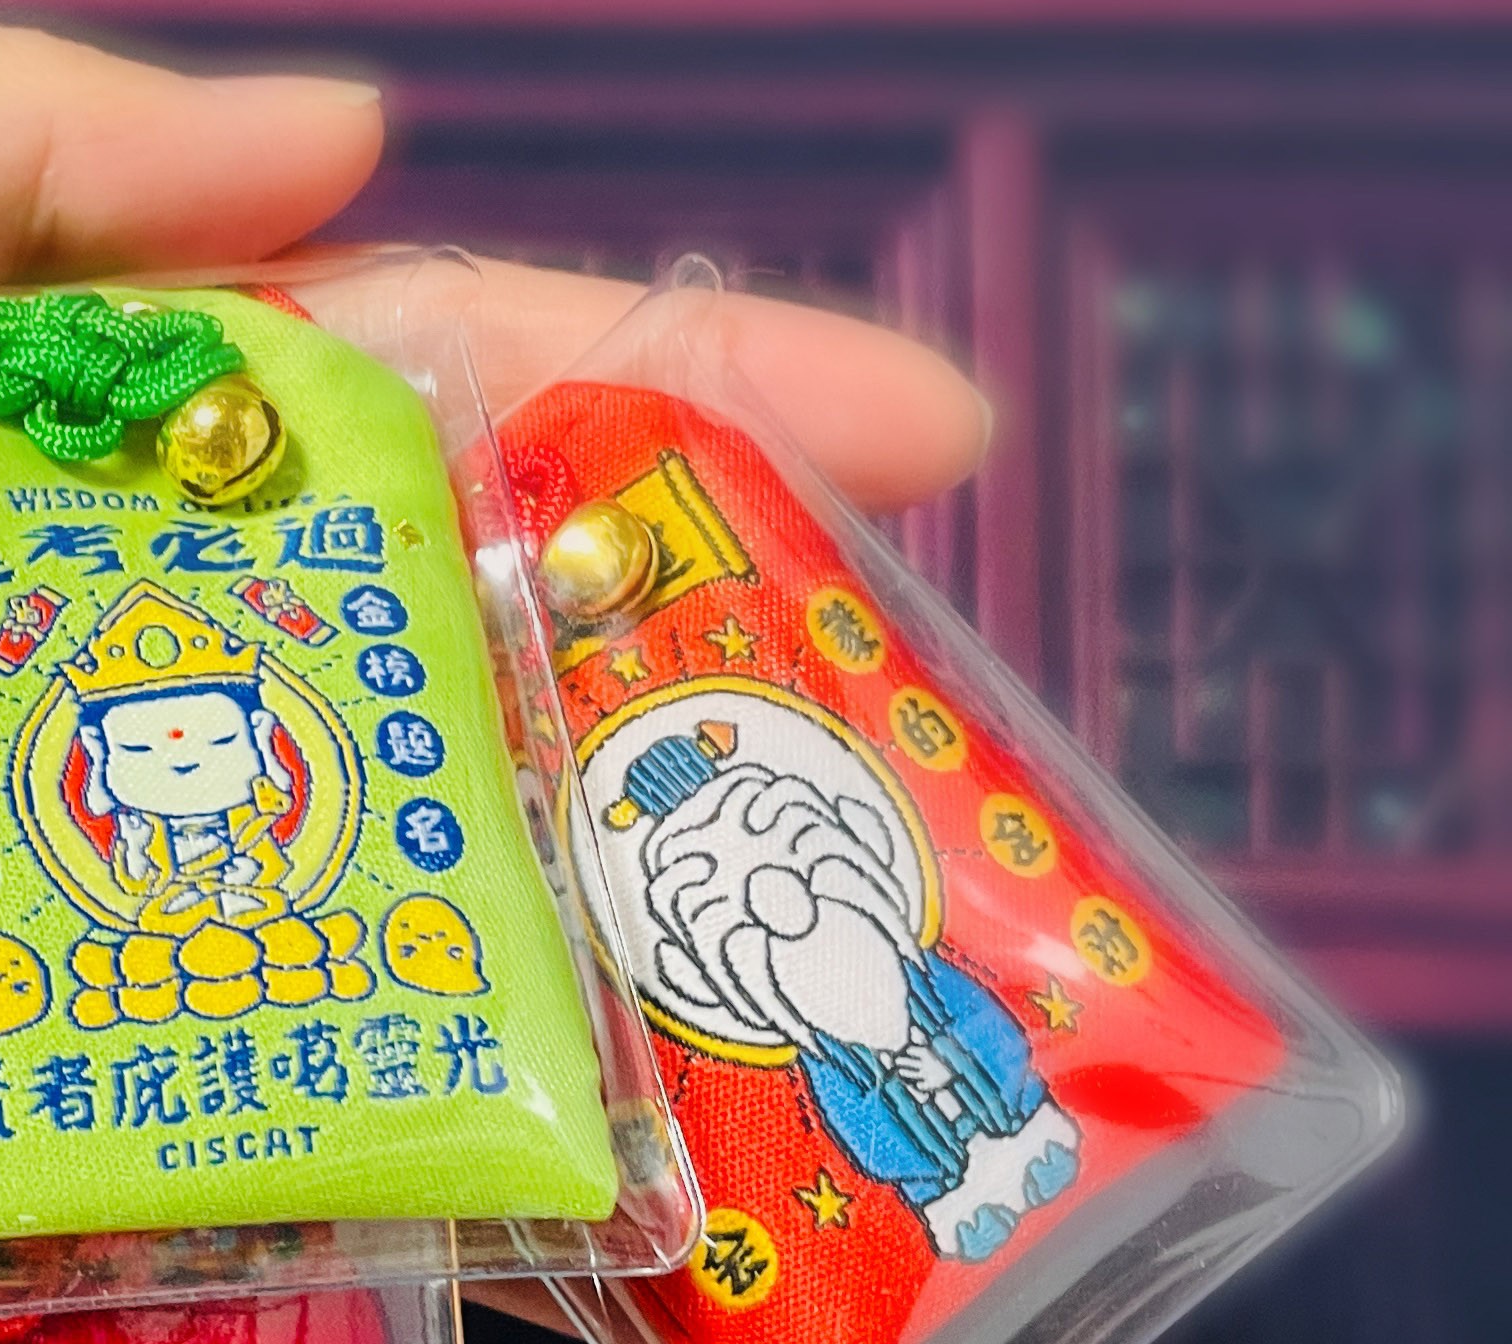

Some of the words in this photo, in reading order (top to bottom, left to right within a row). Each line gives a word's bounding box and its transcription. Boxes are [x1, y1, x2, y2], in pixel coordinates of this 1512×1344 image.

[7, 487, 160, 513] WISDOM
[346, 590, 450, 854] 金榜题名
[816, 597, 1141, 978] 蒙的全对
[157, 1125, 320, 1171] CISCAT
